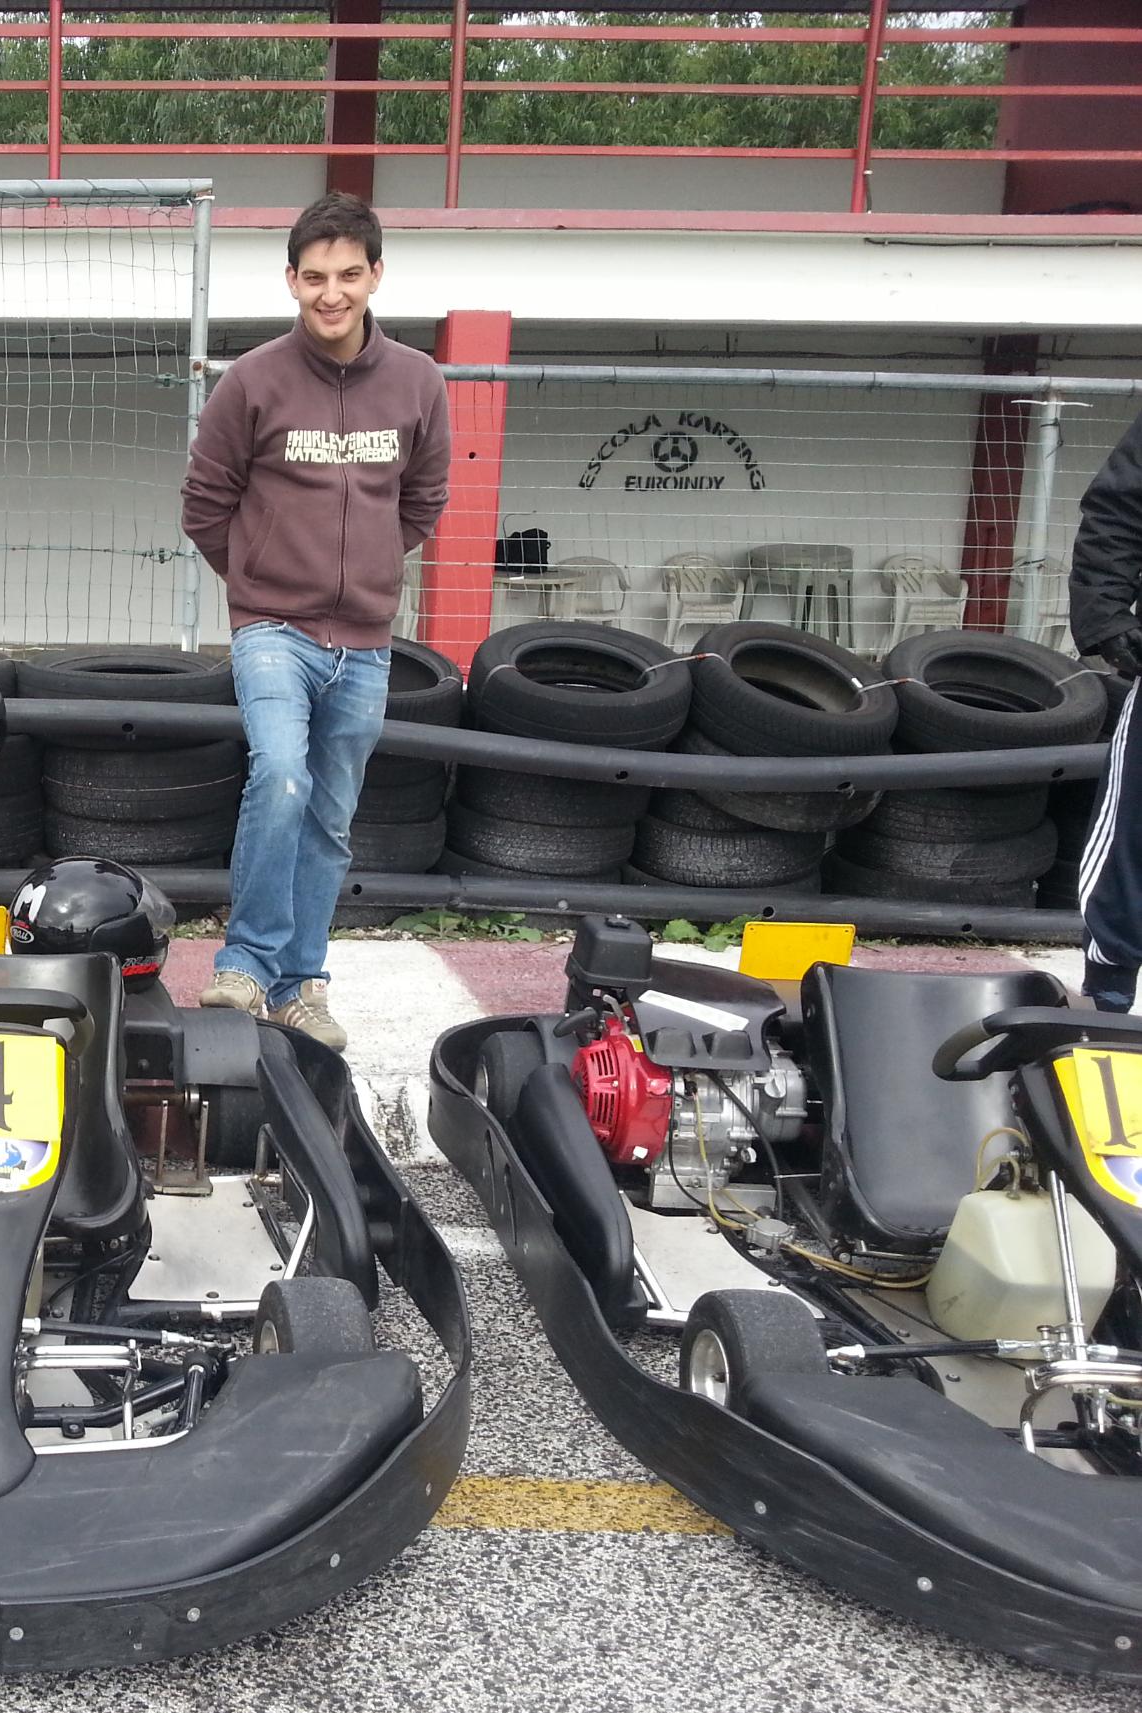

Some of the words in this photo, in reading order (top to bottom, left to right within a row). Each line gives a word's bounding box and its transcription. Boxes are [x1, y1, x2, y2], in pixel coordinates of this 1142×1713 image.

[291, 430, 349, 452] HURLEY
[356, 429, 400, 449] INTER
[578, 413, 662, 490] ESCOLA
[678, 411, 766, 490] KARTING
[284, 447, 348, 464] NATIONAL
[353, 447, 400, 464] FREEDOM
[624, 475, 726, 491] EUROINDY
